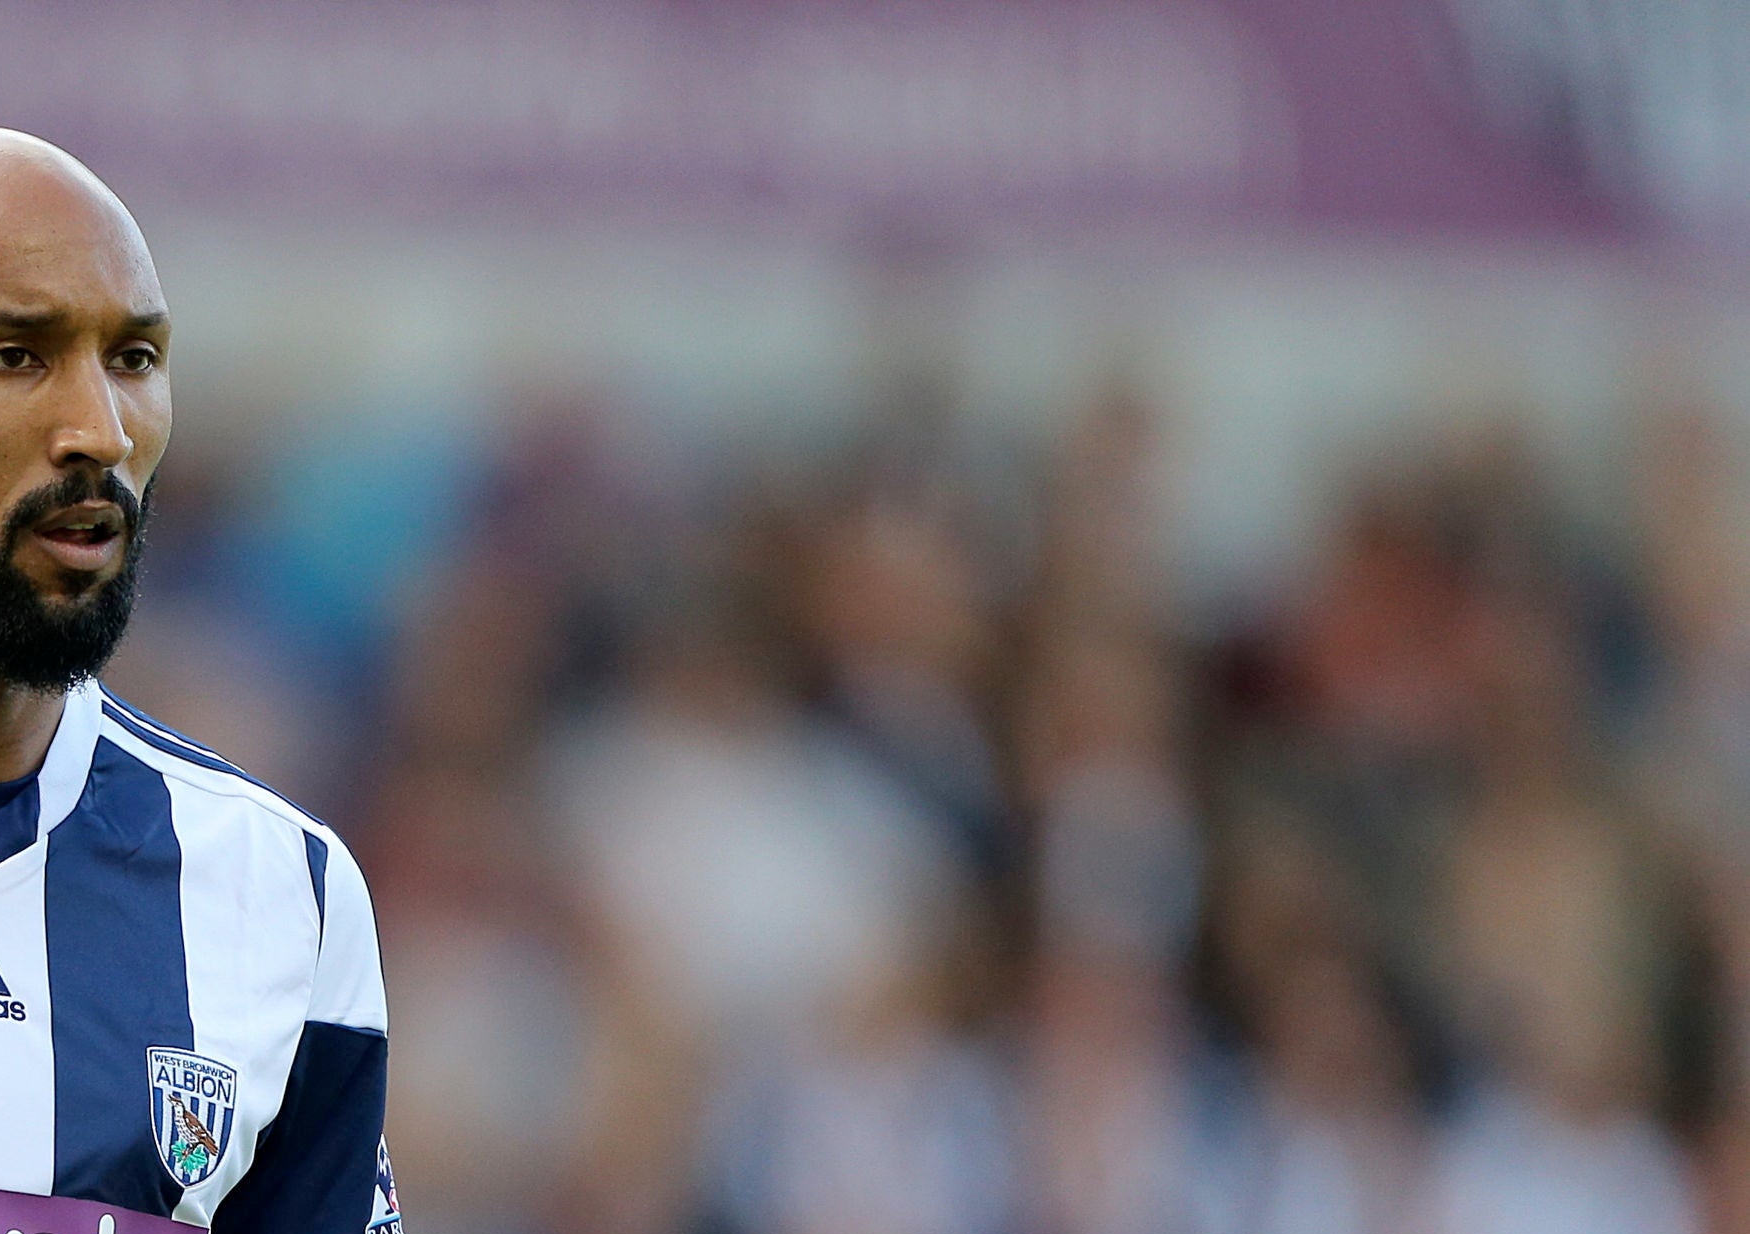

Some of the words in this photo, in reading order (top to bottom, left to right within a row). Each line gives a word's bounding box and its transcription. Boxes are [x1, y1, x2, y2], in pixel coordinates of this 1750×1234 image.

[154, 1053, 181, 1067] WEST
[182, 1060, 233, 1081] BROMWICH
[156, 1065, 231, 1103] ALBION
